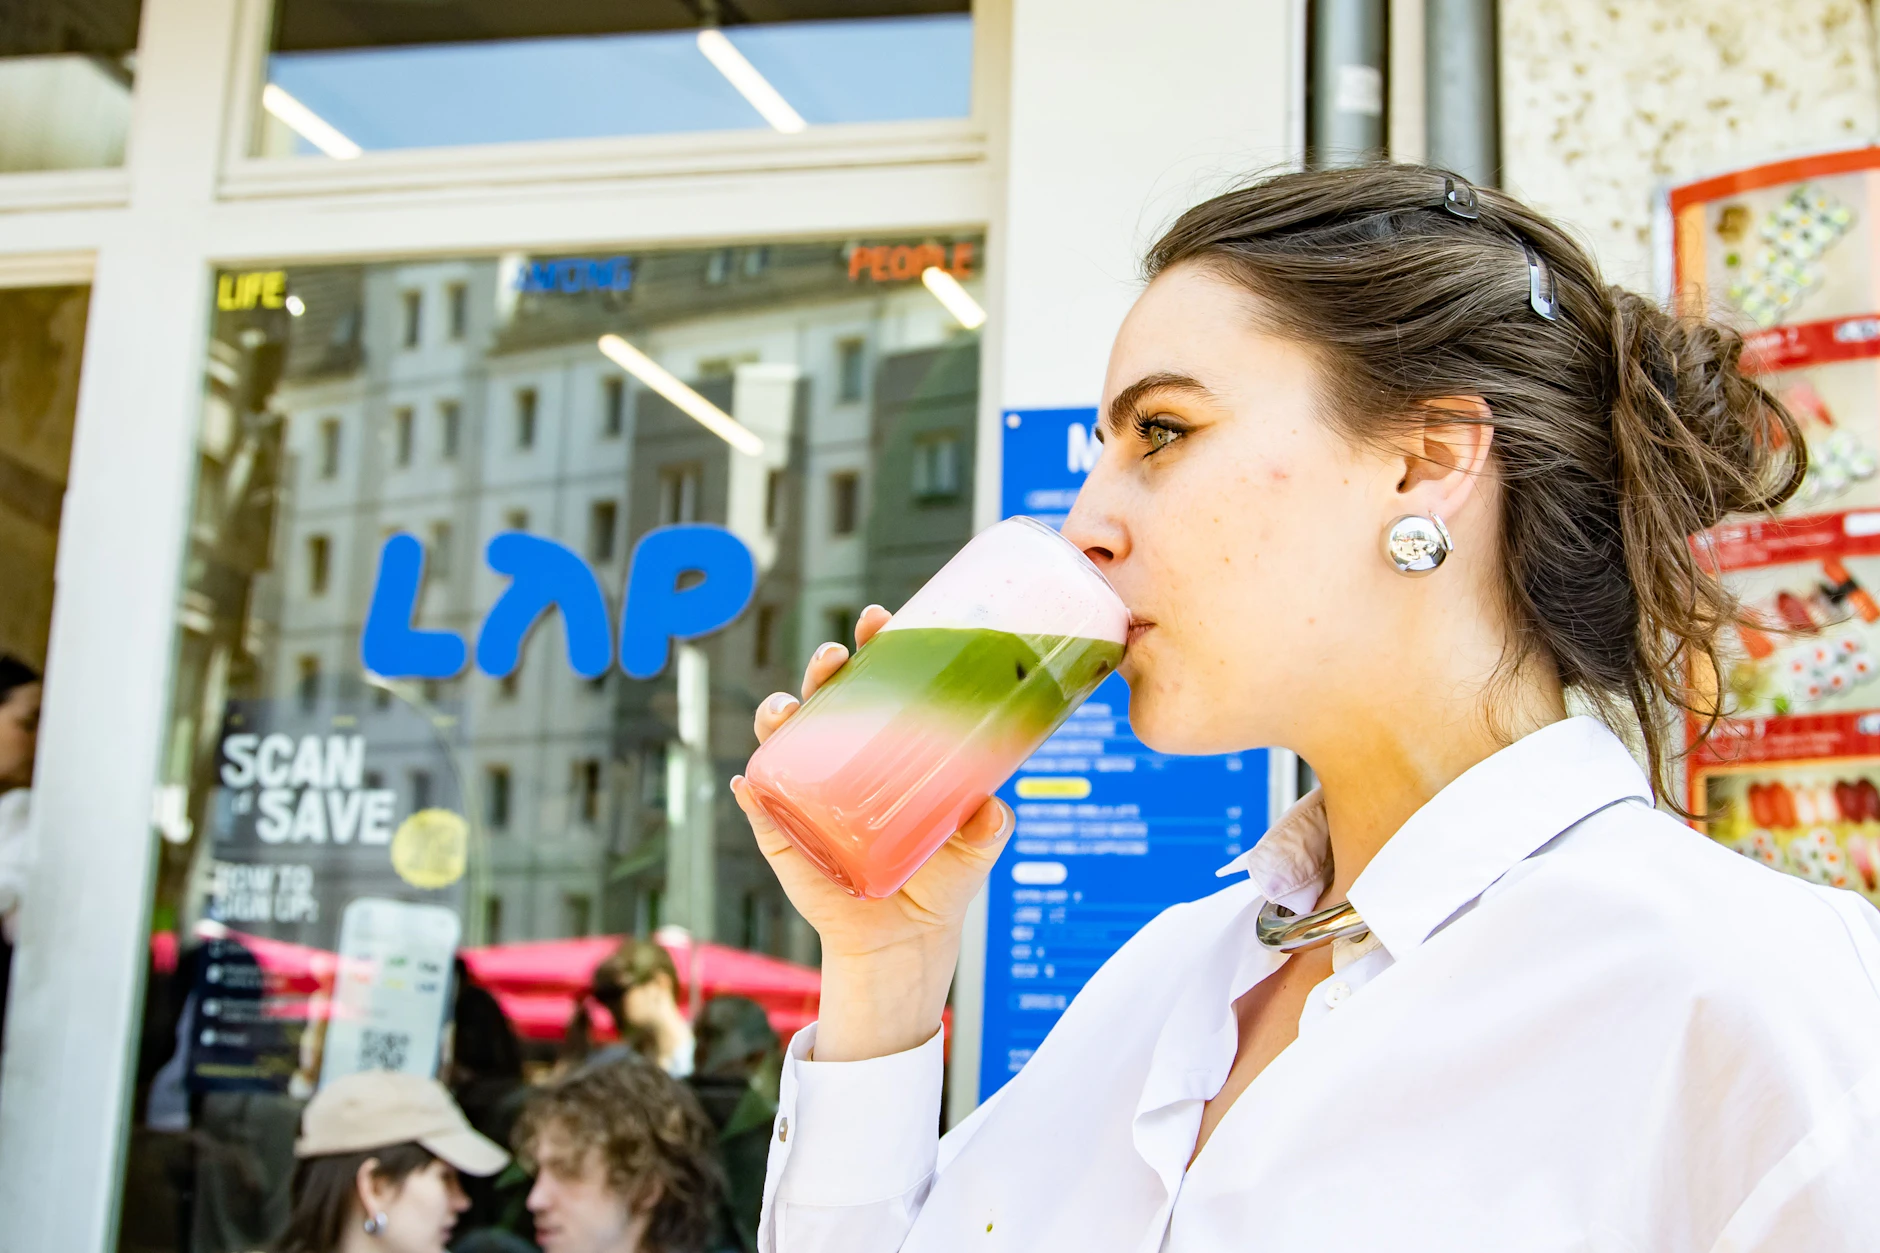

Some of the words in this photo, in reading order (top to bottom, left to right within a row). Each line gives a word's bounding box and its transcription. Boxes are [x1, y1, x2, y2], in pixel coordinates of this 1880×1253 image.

[217, 270, 286, 311] LIFE
[512, 256, 632, 293] AMONG
[848, 242, 974, 282] PEOPLE
[361, 523, 757, 680] LAP
[220, 733, 366, 788] SCAN
[255, 788, 397, 845] SAVE
